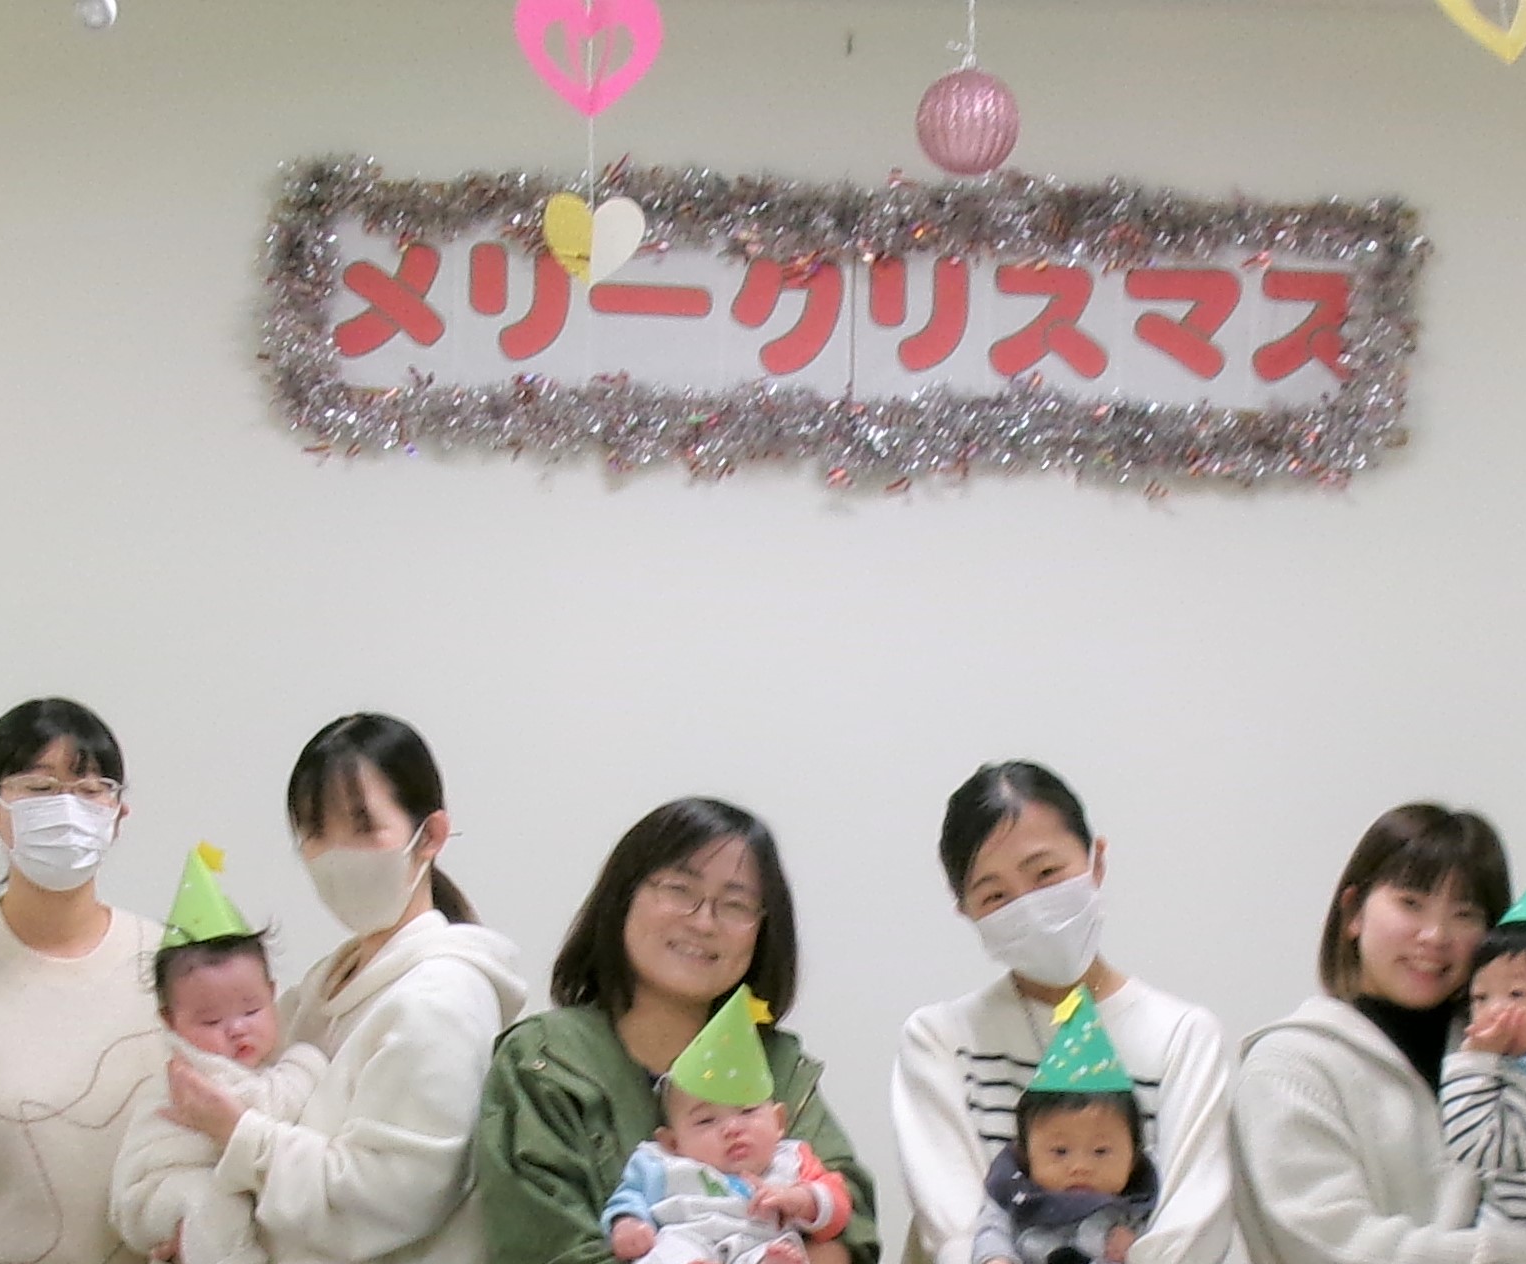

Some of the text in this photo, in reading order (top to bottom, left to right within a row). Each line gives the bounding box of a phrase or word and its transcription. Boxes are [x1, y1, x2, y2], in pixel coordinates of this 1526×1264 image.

[335, 243, 1352, 379] メリークリスマス
